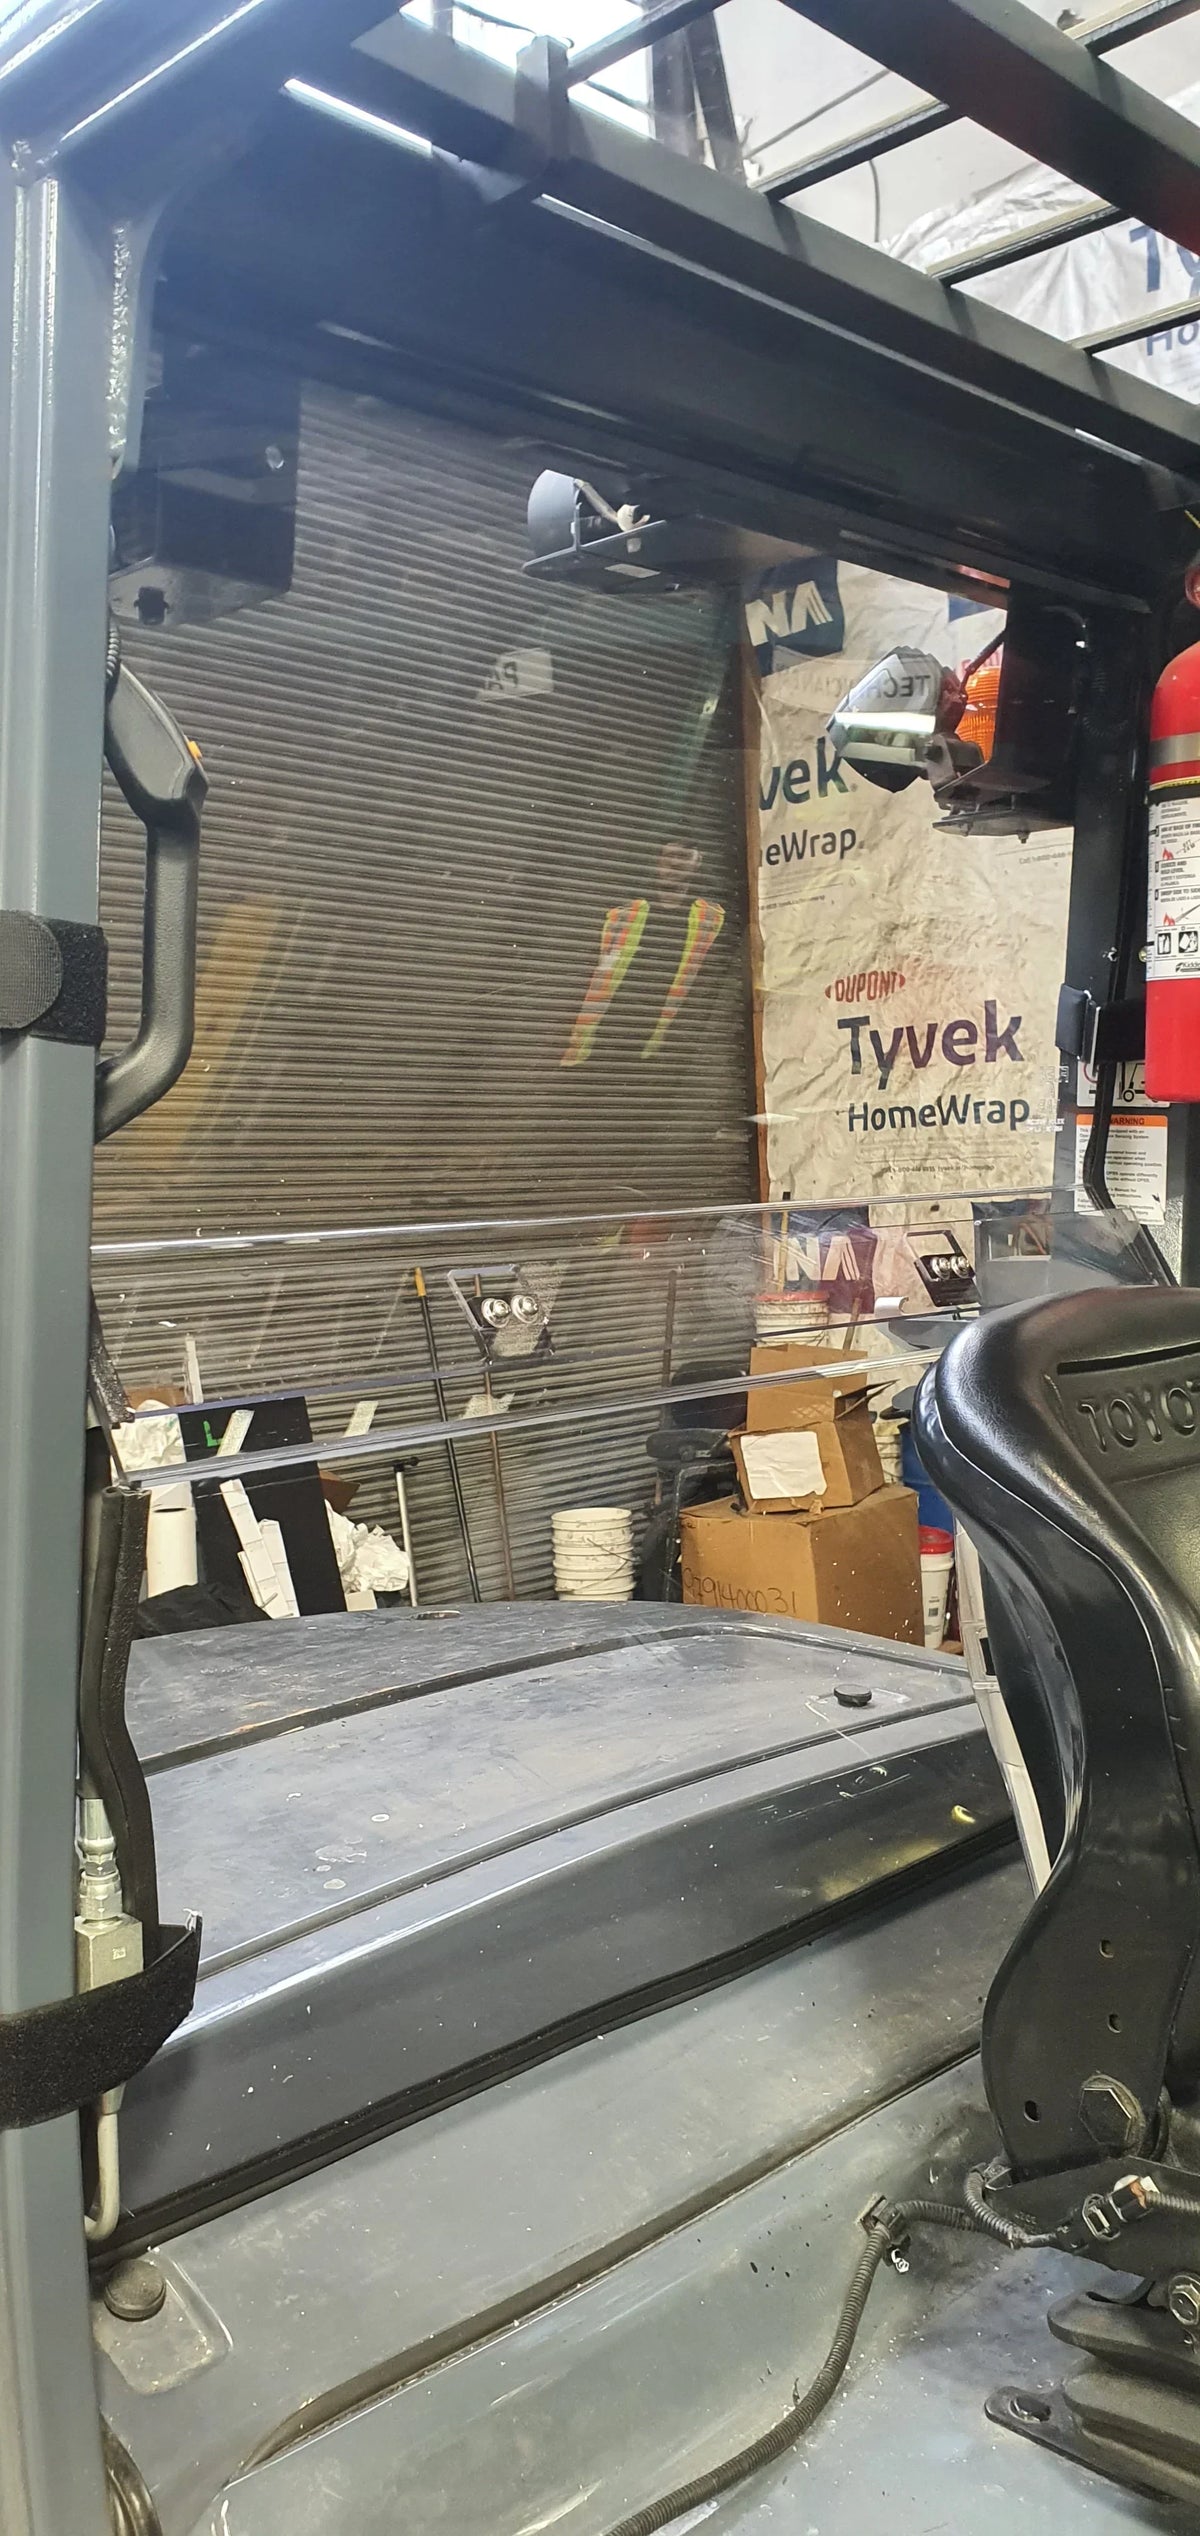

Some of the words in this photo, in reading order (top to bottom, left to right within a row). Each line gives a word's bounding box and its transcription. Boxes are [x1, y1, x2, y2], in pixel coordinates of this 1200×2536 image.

[835, 970, 897, 1003] DUPONT
[837, 999, 1025, 1090] Tyvek
[848, 1093, 1031, 1132] HomeWrap
